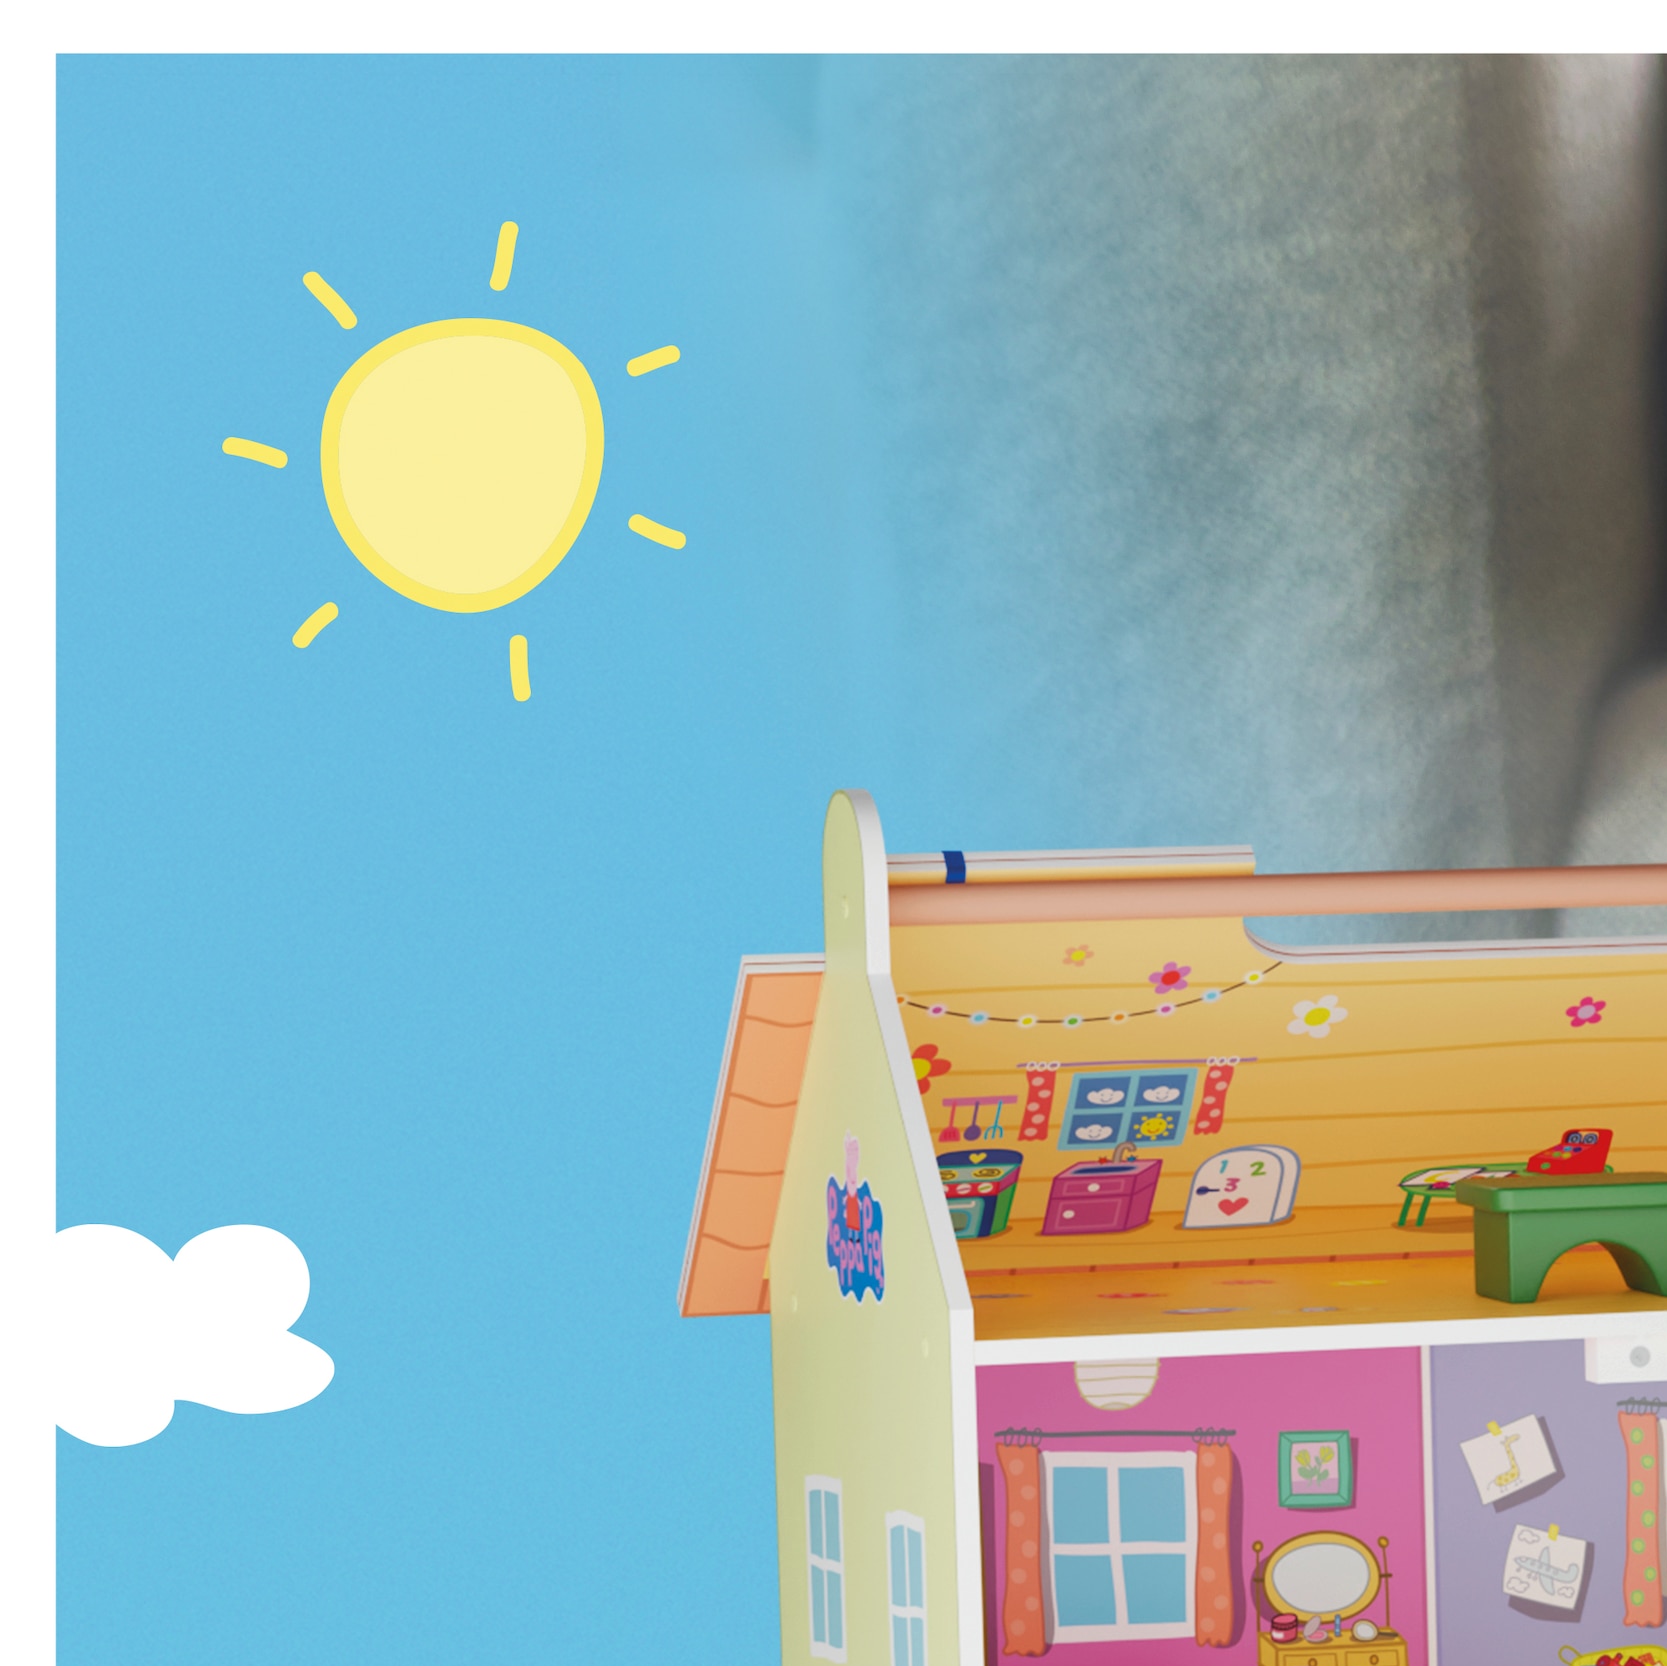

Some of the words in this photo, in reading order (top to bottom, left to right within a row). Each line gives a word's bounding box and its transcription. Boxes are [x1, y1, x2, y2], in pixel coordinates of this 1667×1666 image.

[1219, 1160, 1228, 1174] 1
[1250, 1161, 1267, 1176] 2
[1224, 1178, 1240, 1192] 3
[828, 1186, 865, 1287] Peppa
[863, 1196, 884, 1288] Pig
